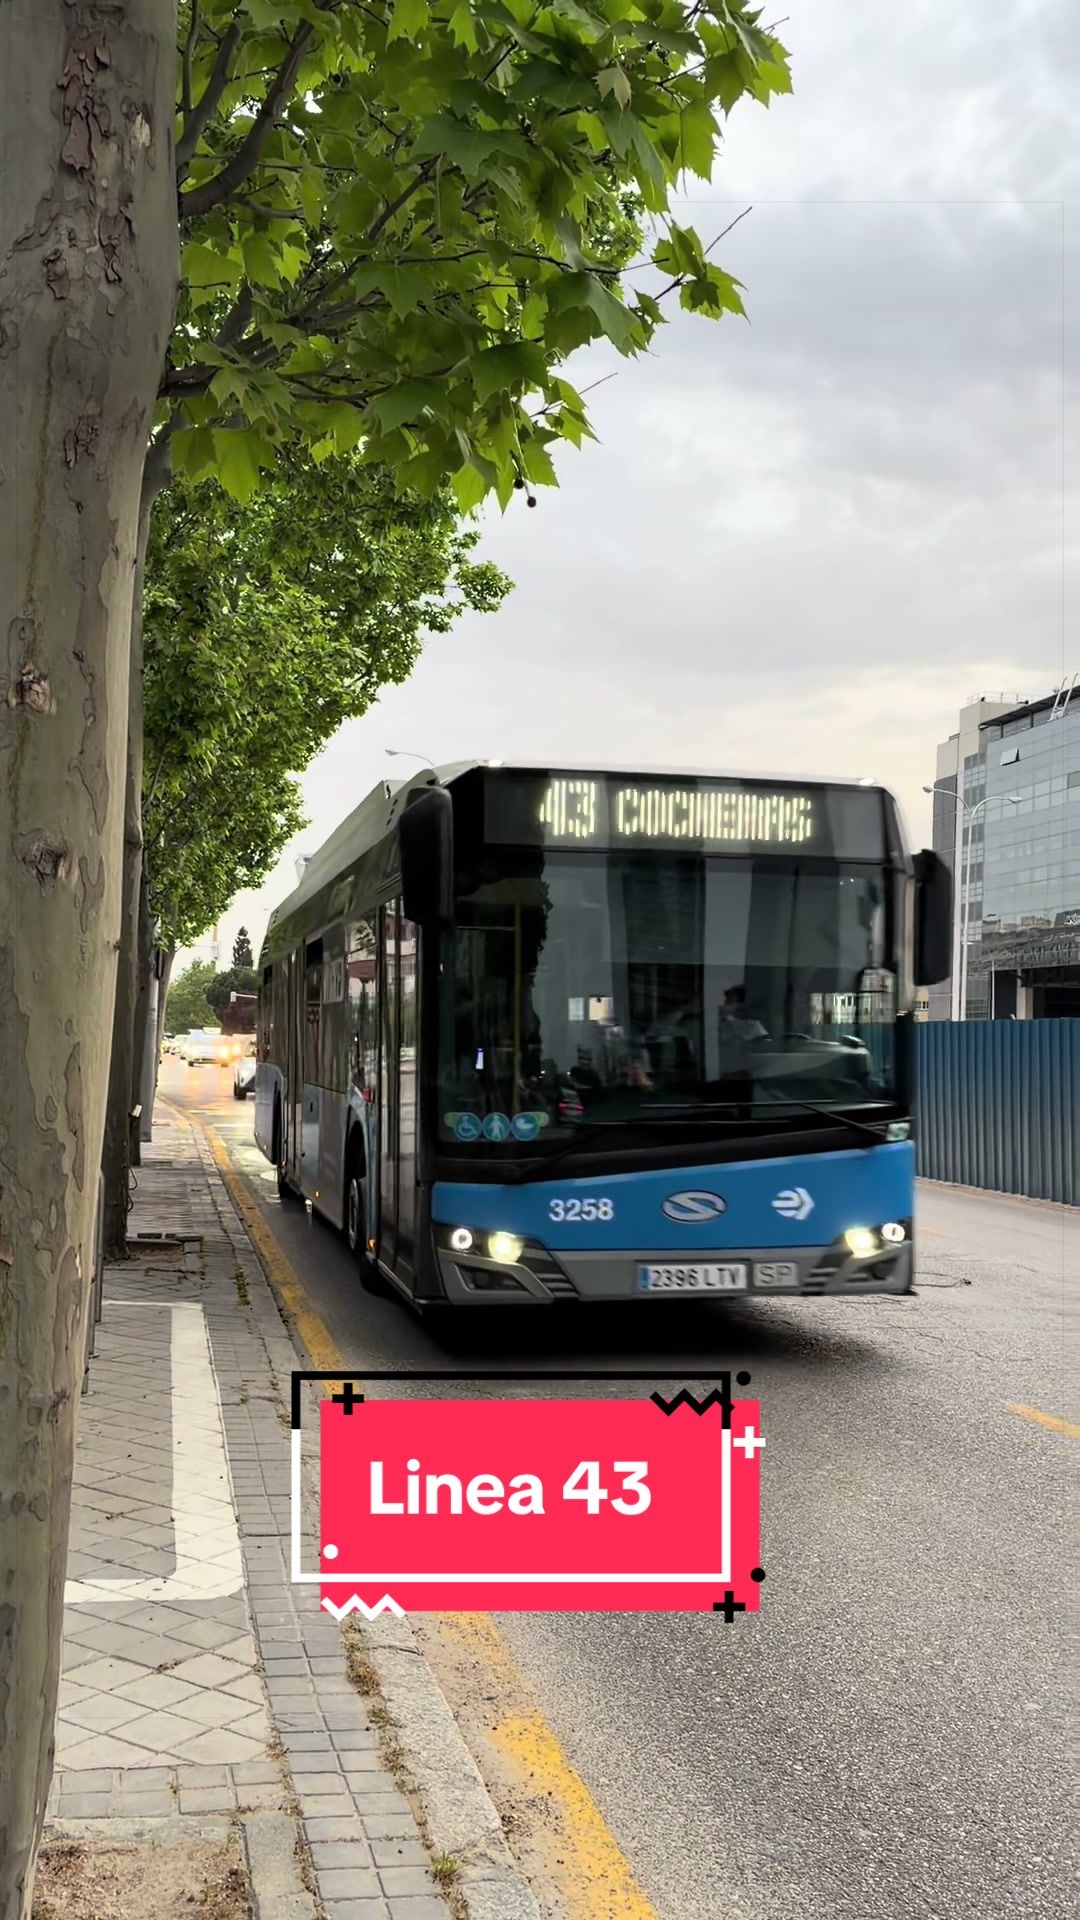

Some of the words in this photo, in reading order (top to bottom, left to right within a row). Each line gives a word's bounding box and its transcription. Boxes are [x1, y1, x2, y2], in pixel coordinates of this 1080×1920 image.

[540, 779, 597, 838] 43
[548, 1197, 614, 1222] 3258
[651, 1267, 699, 1288] 2396
[704, 1266, 740, 1287] LTV
[759, 1264, 793, 1285] SP
